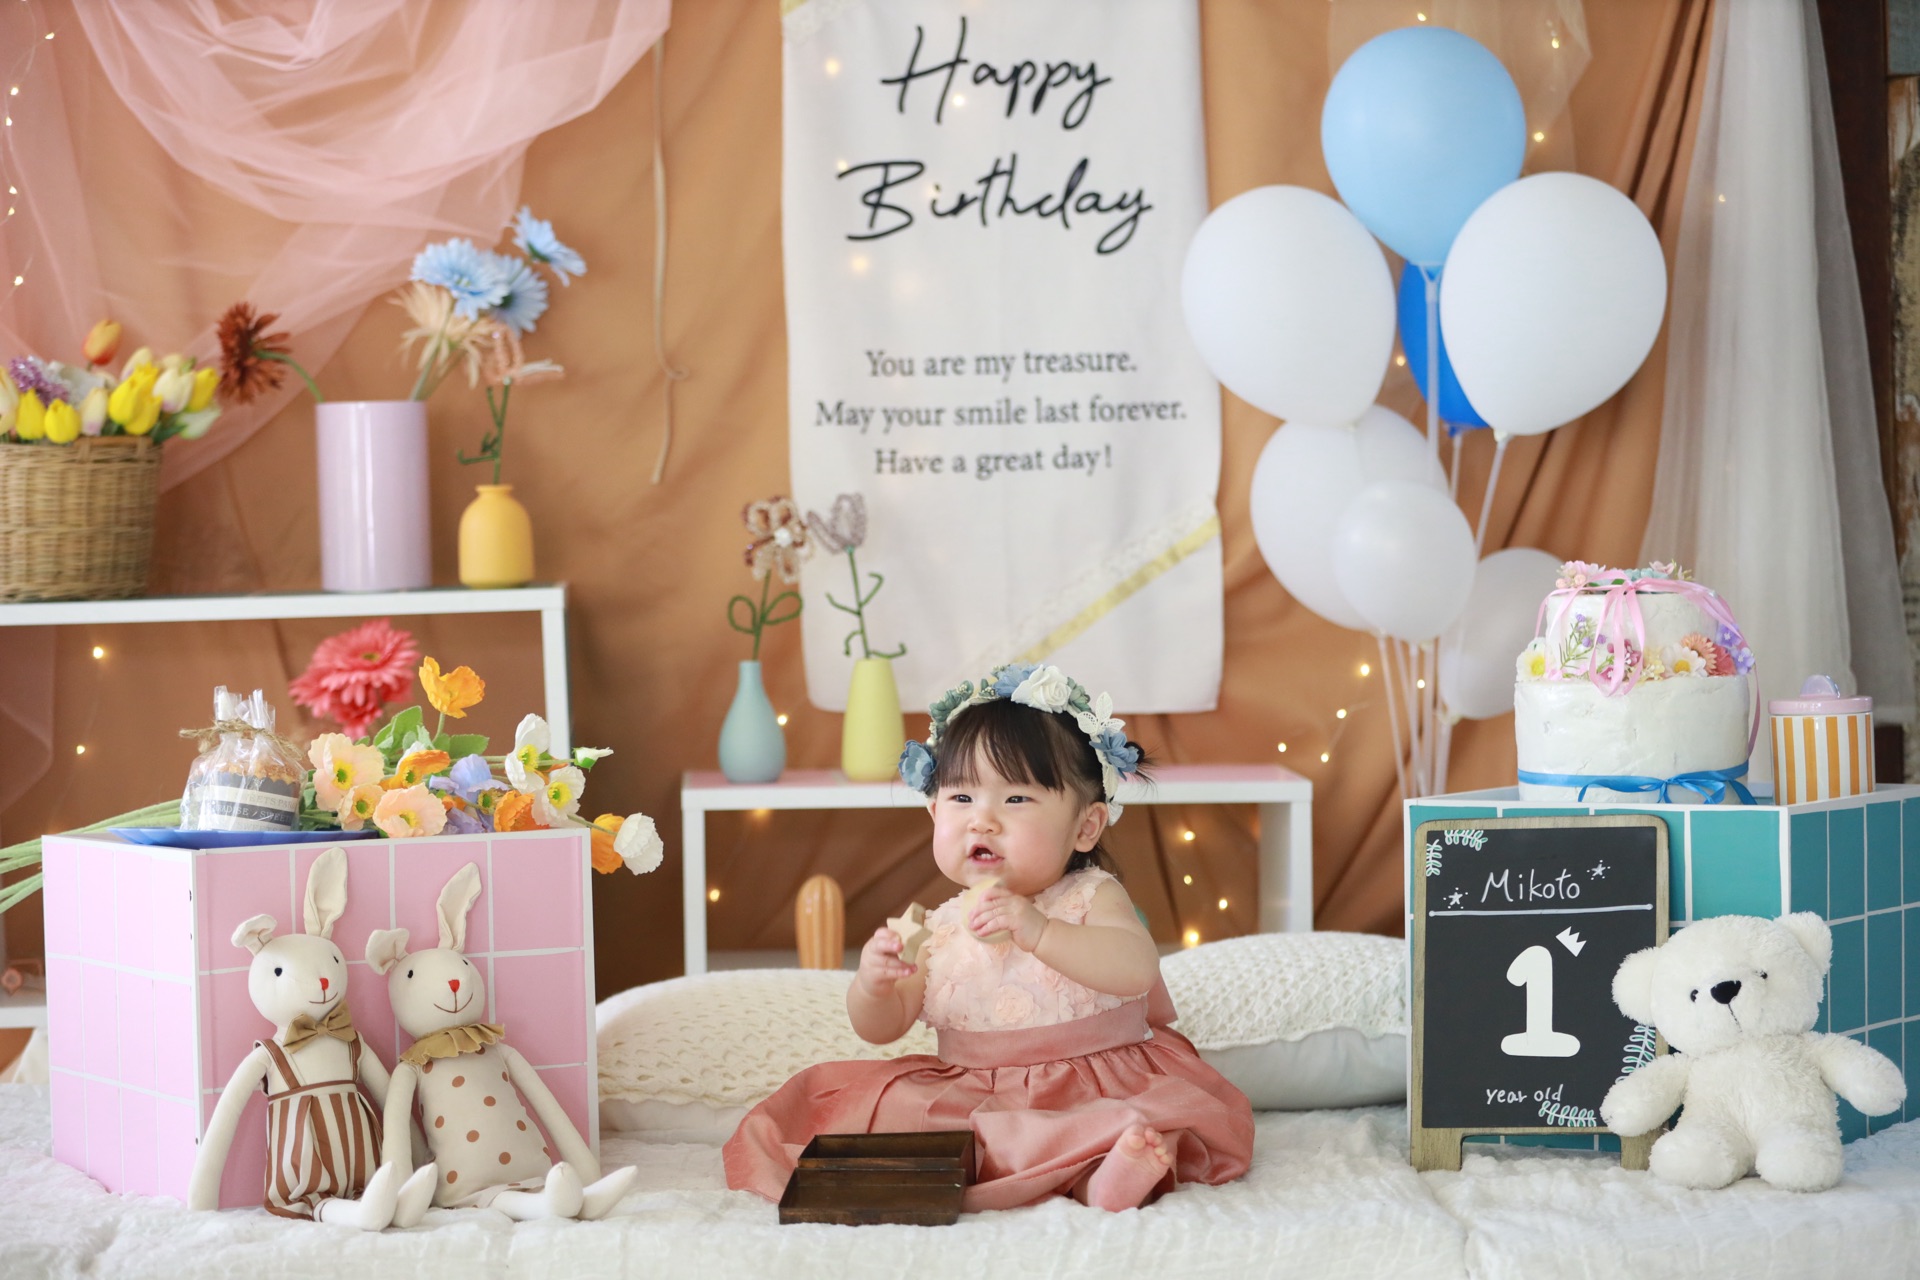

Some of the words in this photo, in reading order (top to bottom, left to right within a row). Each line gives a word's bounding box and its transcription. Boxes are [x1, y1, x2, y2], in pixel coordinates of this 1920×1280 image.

[880, 16, 1112, 130] Happy
[836, 153, 1153, 255] Birthday
[866, 350, 914, 377] You
[924, 356, 965, 376] are
[974, 356, 1015, 383] my
[1023, 351, 1137, 374] treasure.
[816, 400, 874, 433] May
[882, 407, 945, 434] your
[954, 398, 1027, 425] smile
[1036, 397, 1079, 423] last
[1089, 395, 1186, 422] forever.
[875, 448, 944, 474] Have
[952, 456, 966, 473] a
[975, 450, 1043, 480] great
[1052, 445, 1112, 475] day!
[1481, 869, 1580, 903] Mikoto
[1501, 945, 1581, 1057] 1
[1486, 1088, 1527, 1104] year
[1534, 1084, 1564, 1102] old
